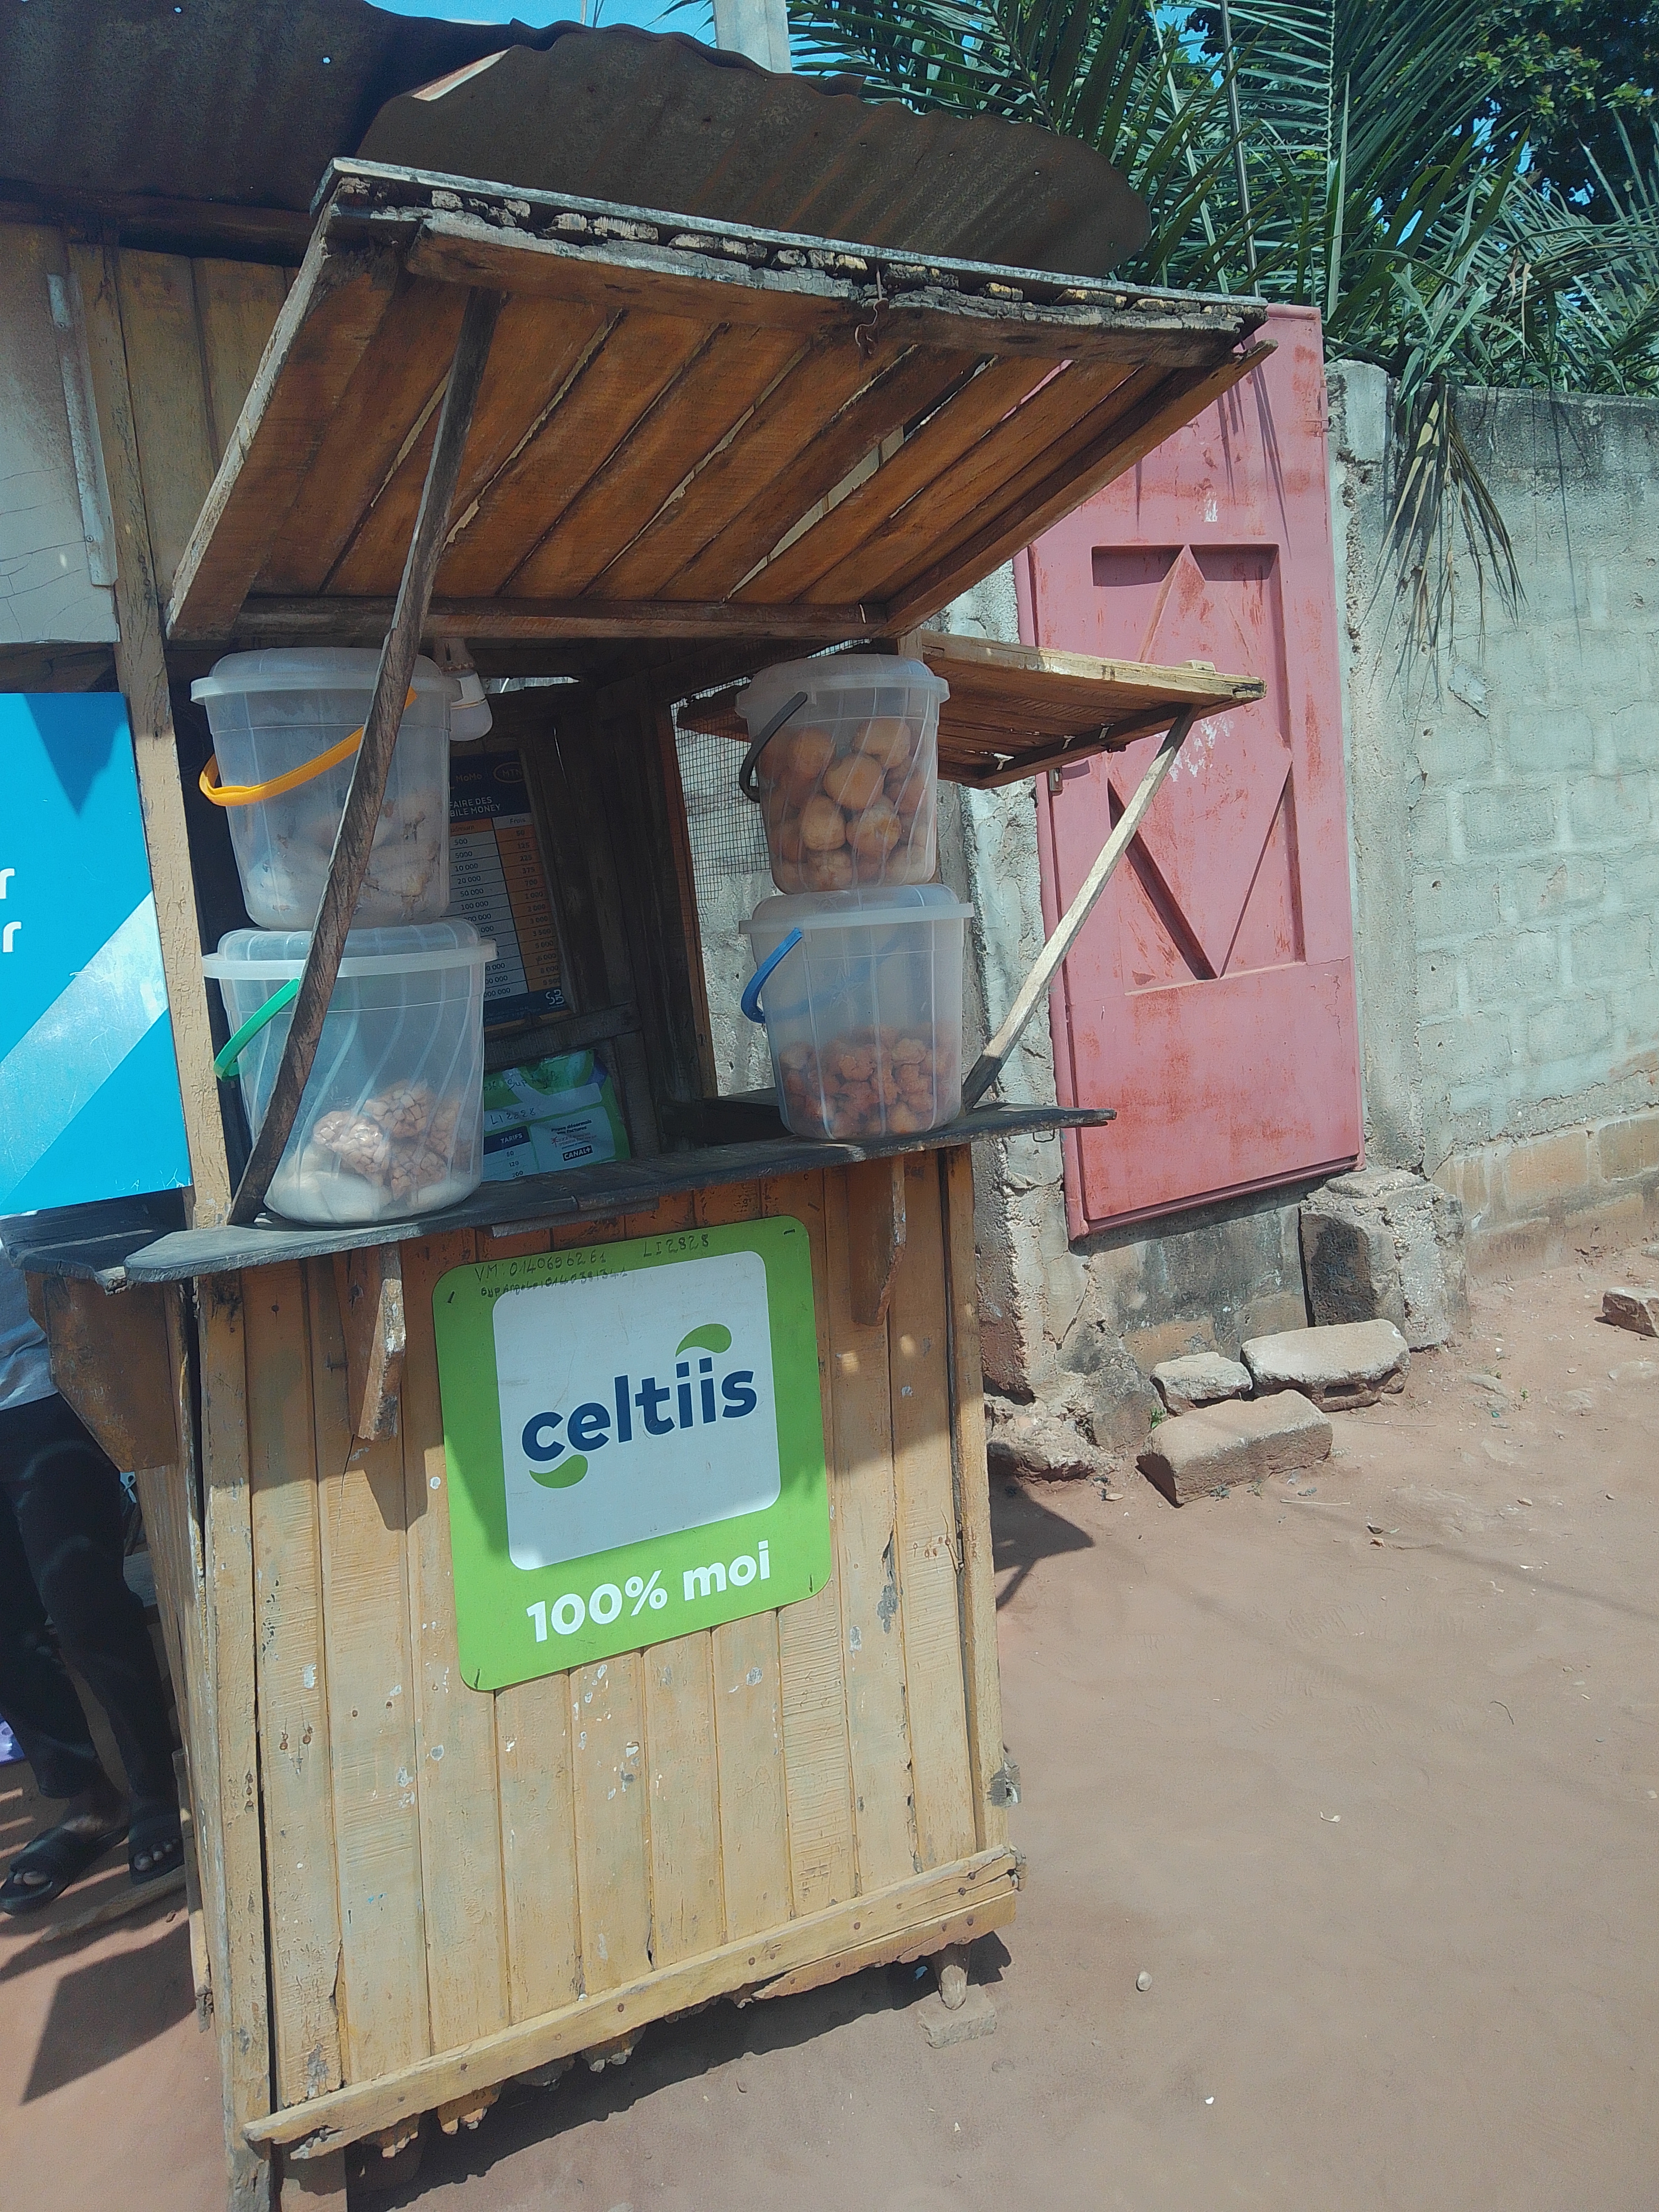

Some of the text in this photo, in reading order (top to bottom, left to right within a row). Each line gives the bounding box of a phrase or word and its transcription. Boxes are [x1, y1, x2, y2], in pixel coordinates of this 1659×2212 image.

[456, 773, 482, 782] MoMo
[502, 768, 522, 777] MTN
[475, 796, 492, 805] DES
[450, 803, 501, 817] BILE MONEY
[500, 1133, 523, 1144] TARIFS
[564, 1146, 591, 1160] CANAL+
[521, 1356, 758, 1462] celtiis
[526, 1539, 771, 1643] 100% moi
